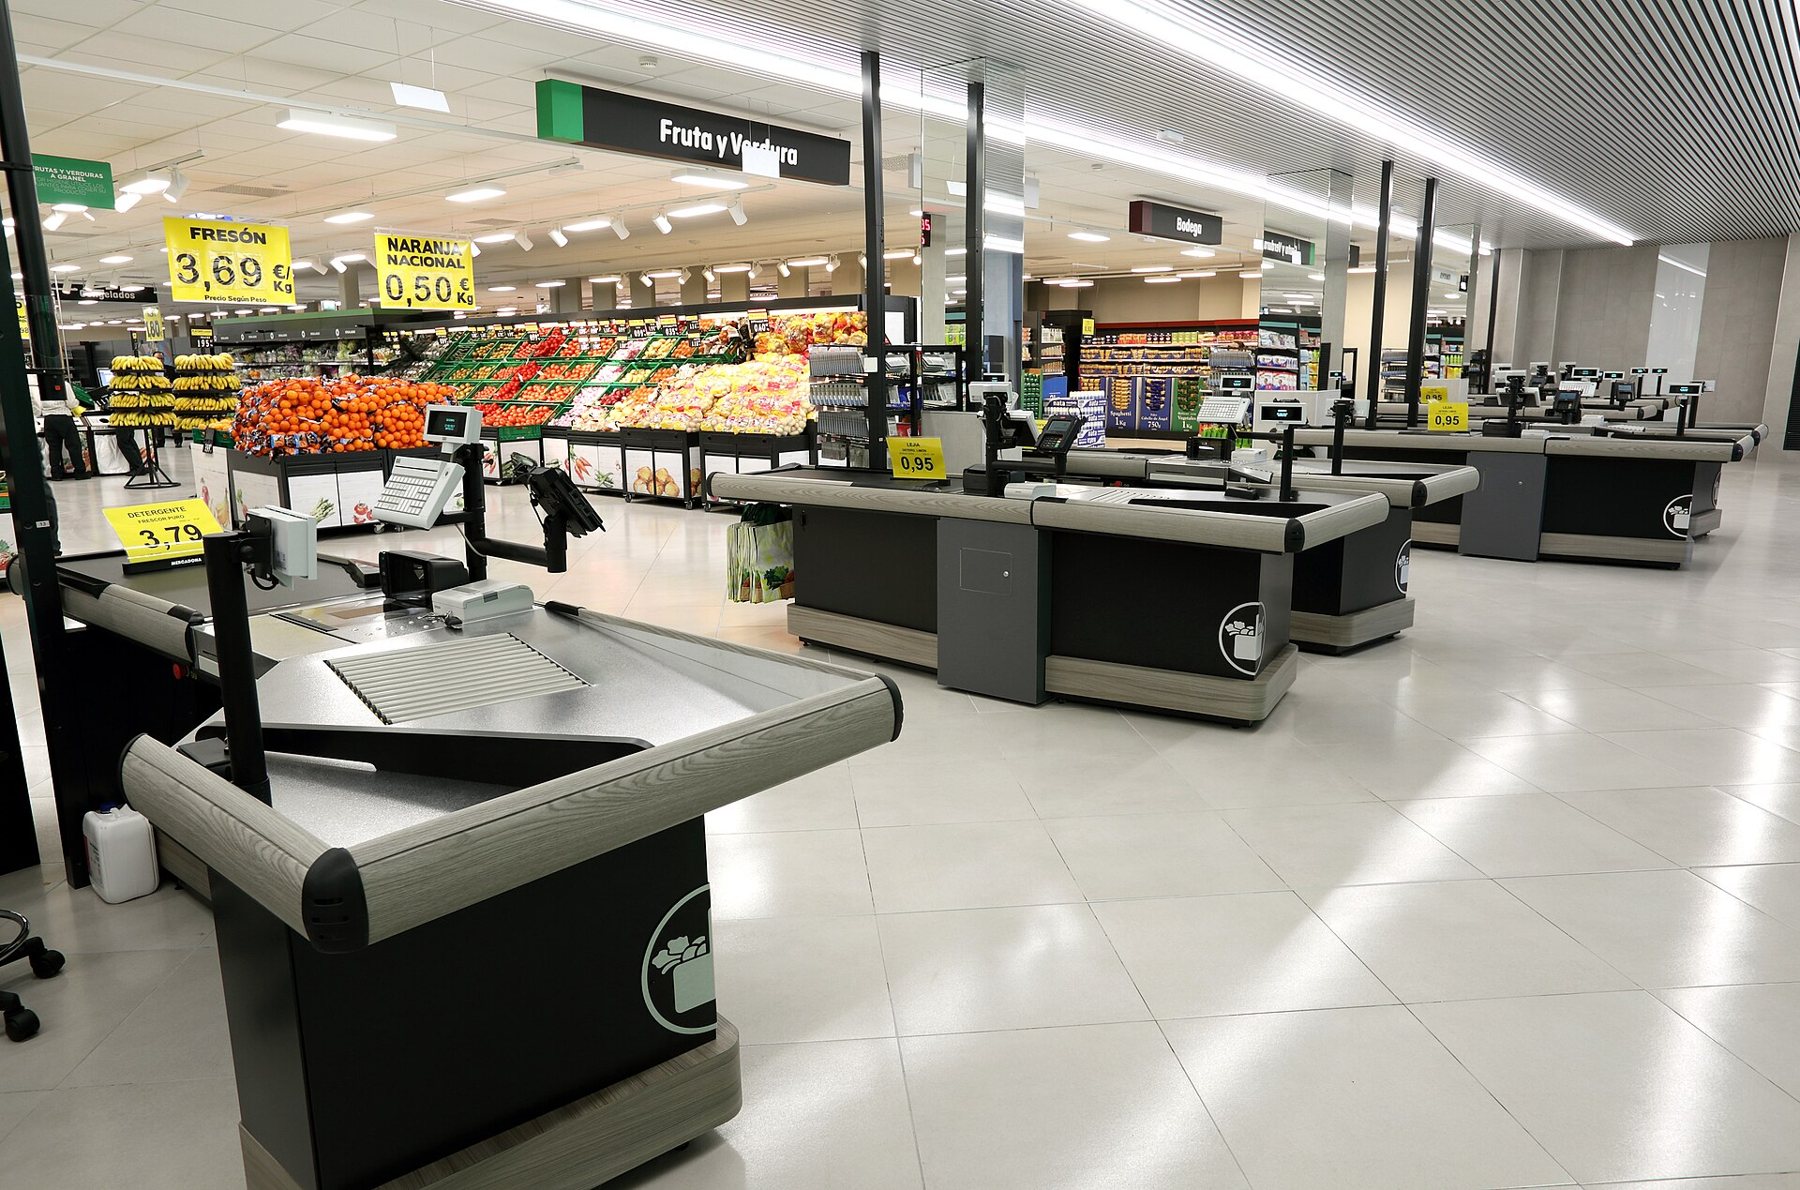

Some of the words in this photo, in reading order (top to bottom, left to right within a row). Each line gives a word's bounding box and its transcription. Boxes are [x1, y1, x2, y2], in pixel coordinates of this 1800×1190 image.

[660, 119, 713, 151] Fruta
[716, 135, 728, 158] y
[58, 174, 86, 182] GRANEL
[66, 170, 104, 179] VERDURAS
[1177, 217, 1202, 237] Bodega
[190, 228, 266, 245] FRESÓN
[388, 238, 462, 256] NARANJA
[387, 254, 465, 269] NACIONAL
[176, 254, 261, 291] 3,69
[80, 289, 136, 301] Cgelados
[274, 281, 292, 294] Kg
[386, 274, 452, 307] 0,50
[457, 292, 474, 306] Kg
[1436, 416, 1460, 426] 0,95
[901, 456, 934, 472] 0,95
[128, 506, 187, 519] DETERGENTE
[140, 524, 203, 551] 3,79
